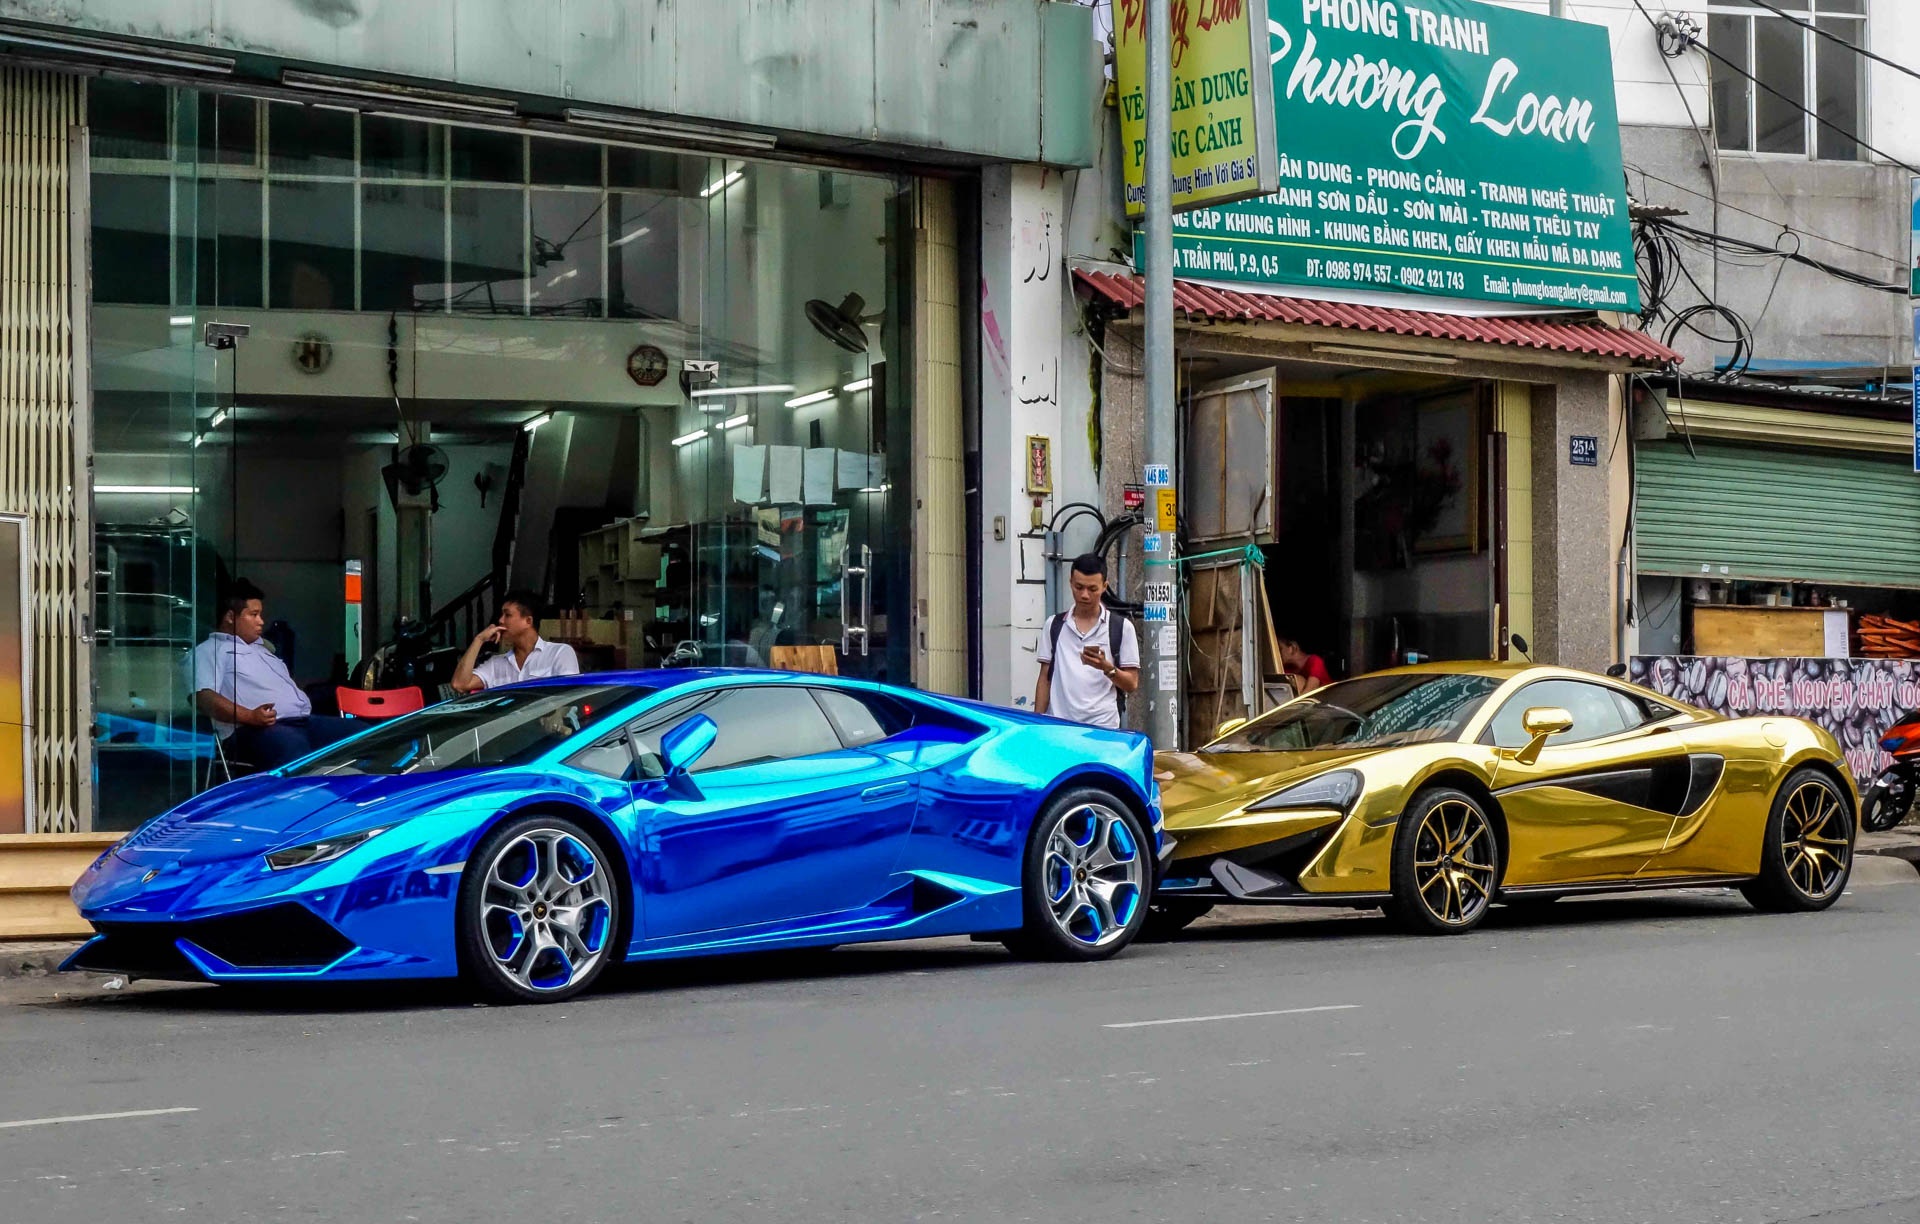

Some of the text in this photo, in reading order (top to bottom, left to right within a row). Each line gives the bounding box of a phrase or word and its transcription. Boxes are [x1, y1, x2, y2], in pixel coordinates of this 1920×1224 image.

[1404, 6, 1489, 55] TRANH
[1201, 68, 1248, 105] DUNG
[1470, 57, 1595, 143] Loan
[1195, 112, 1243, 153] CẢNH
[1172, 174, 1192, 194] hung
[1231, 160, 1244, 181] Giá
[1308, 160, 1352, 185] DUNG
[1367, 168, 1421, 192] PHONG
[1425, 169, 1466, 197] CẢNH
[1479, 182, 1528, 205] TRANH
[1532, 188, 1568, 211] NGHỆ
[1572, 193, 1615, 218] THUẬT
[1317, 190, 1351, 211] SƠN
[1356, 188, 1388, 215] DẦU
[1403, 200, 1435, 220] SƠN
[1440, 201, 1468, 224] MÀI
[1481, 209, 1530, 232] TRANH
[1533, 214, 1571, 236] THÊU
[1574, 221, 1600, 240] TAY
[1225, 212, 1274, 235] KHUNG
[1277, 213, 1311, 237] HÌNH
[1324, 221, 1371, 244] KHUNG
[1374, 219, 1410, 248] BẰNG
[1412, 231, 1451, 255] KHEN,
[1454, 230, 1483, 255] GIẤY
[1486, 238, 1520, 258] KHEN
[1523, 235, 1549, 262] MẪU
[1551, 243, 1571, 264] MÃ
[1572, 247, 1589, 266] ĐA
[1590, 249, 1622, 270] DẠNG
[1182, 242, 1211, 270] TRẦN
[1213, 247, 1237, 275] PHÚ,
[1240, 253, 1259, 277] P.9,
[1262, 255, 1279, 277] Q.5
[1306, 258, 1323, 278] ĐT:
[1326, 260, 1351, 280] 0986
[1353, 262, 1372, 282] 974
[1374, 264, 1392, 284] 557
[1400, 267, 1425, 286] 0902
[1427, 269, 1444, 288] 421
[1447, 271, 1465, 290] 743
[1483, 274, 1510, 295] Email:
[1572, 439, 1595, 455] 251A
[1728, 674, 1748, 709] CÀ
[1756, 674, 1785, 709] PHÊ
[1793, 674, 1852, 709] NGUYÊN
